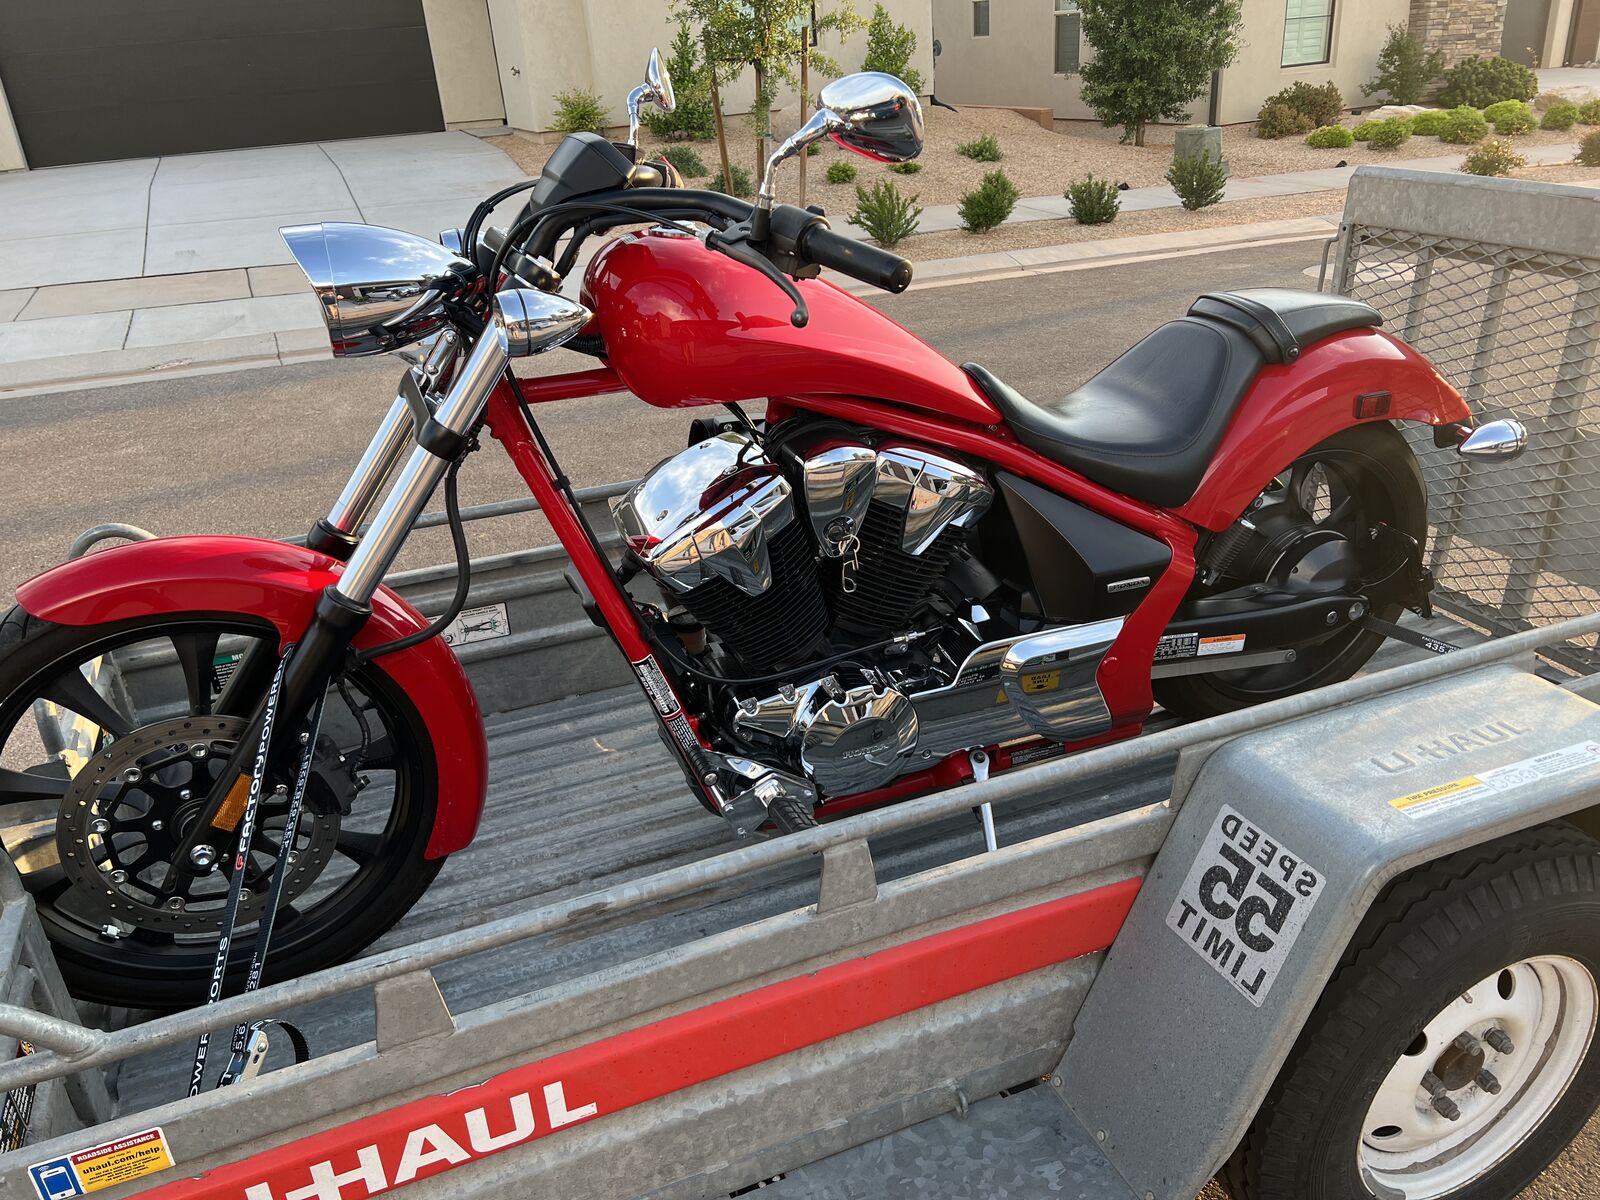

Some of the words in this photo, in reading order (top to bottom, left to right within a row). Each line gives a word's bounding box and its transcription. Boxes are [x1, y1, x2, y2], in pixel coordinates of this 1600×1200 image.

[77, 1147, 113, 1162] ROADSIDE
[114, 1133, 155, 1151] ASSISTANCE
[83, 1146, 160, 1174] uhaul.com/help
